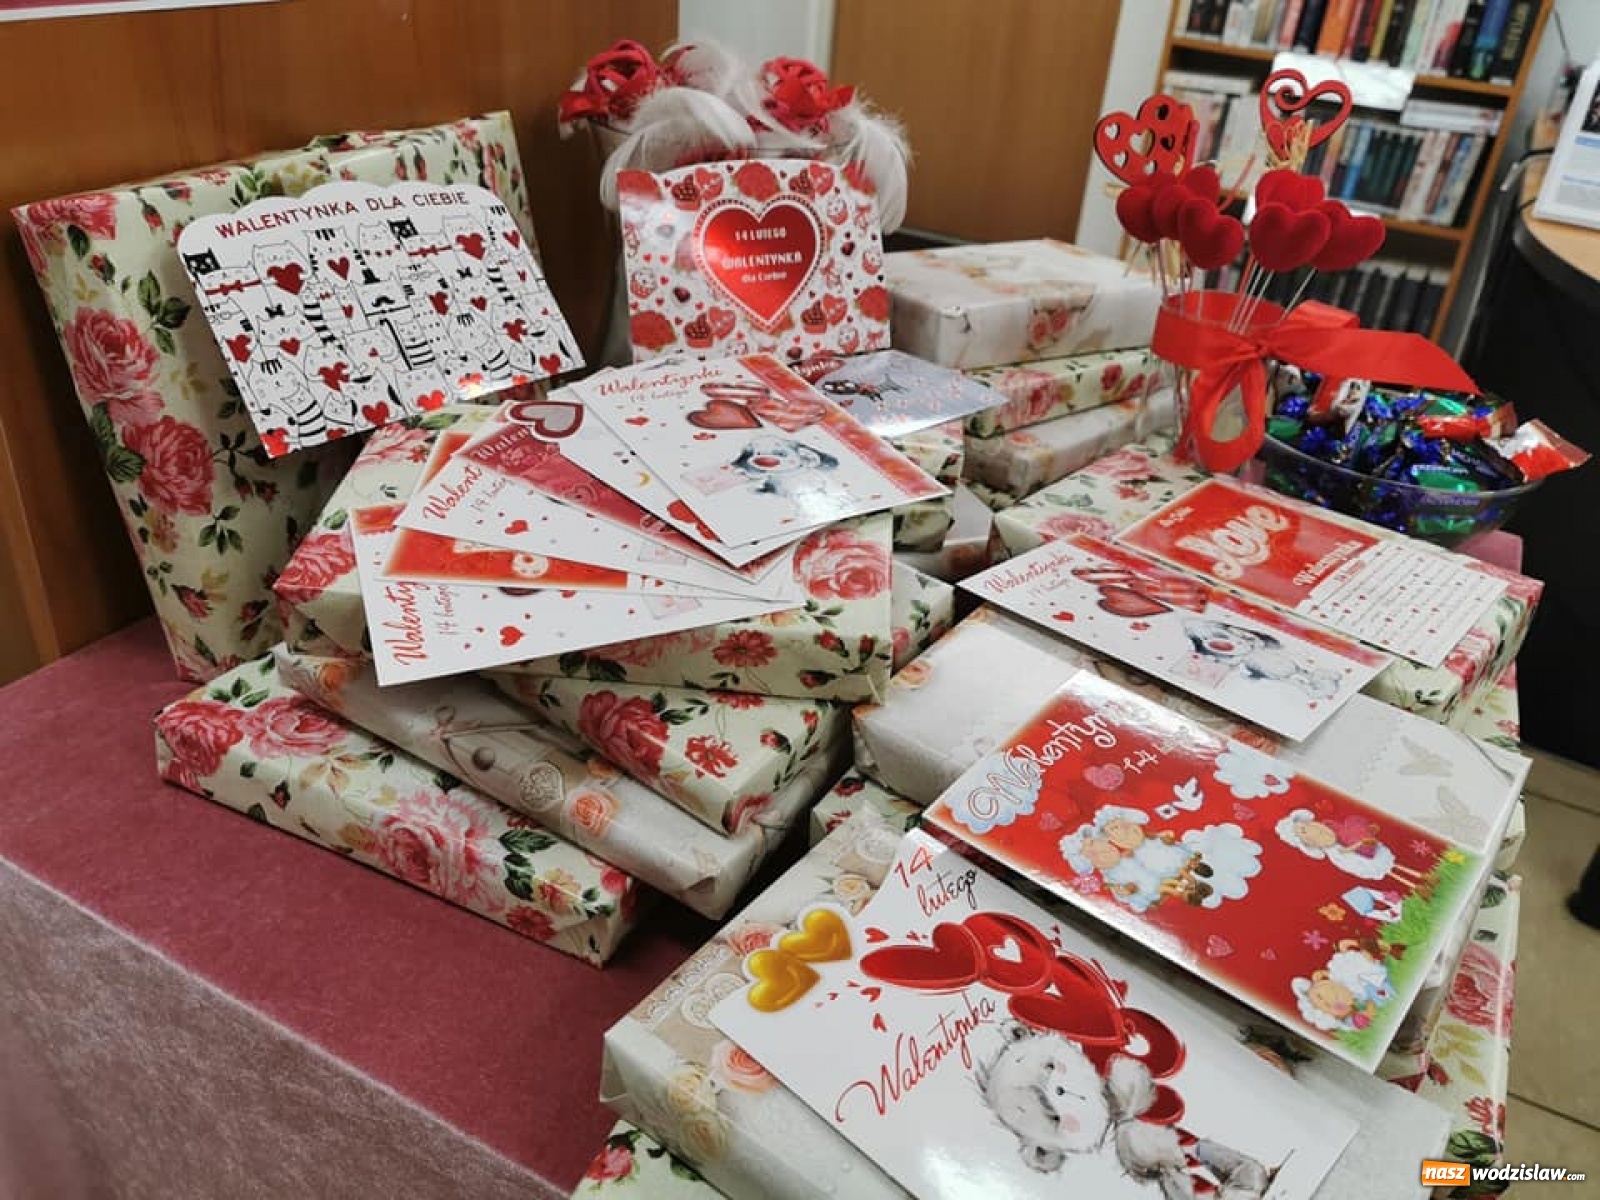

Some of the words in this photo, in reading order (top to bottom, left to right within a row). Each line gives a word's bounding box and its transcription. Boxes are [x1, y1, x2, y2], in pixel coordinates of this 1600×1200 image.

[214, 200, 358, 239] WALENTYNKA
[365, 196, 405, 211] DLA
[412, 191, 469, 206] CIEBIE
[721, 251, 802, 271] WALENTYNKA
[894, 845, 935, 889] 14
[915, 867, 978, 919] lutego
[834, 990, 997, 1123] Walentynka
